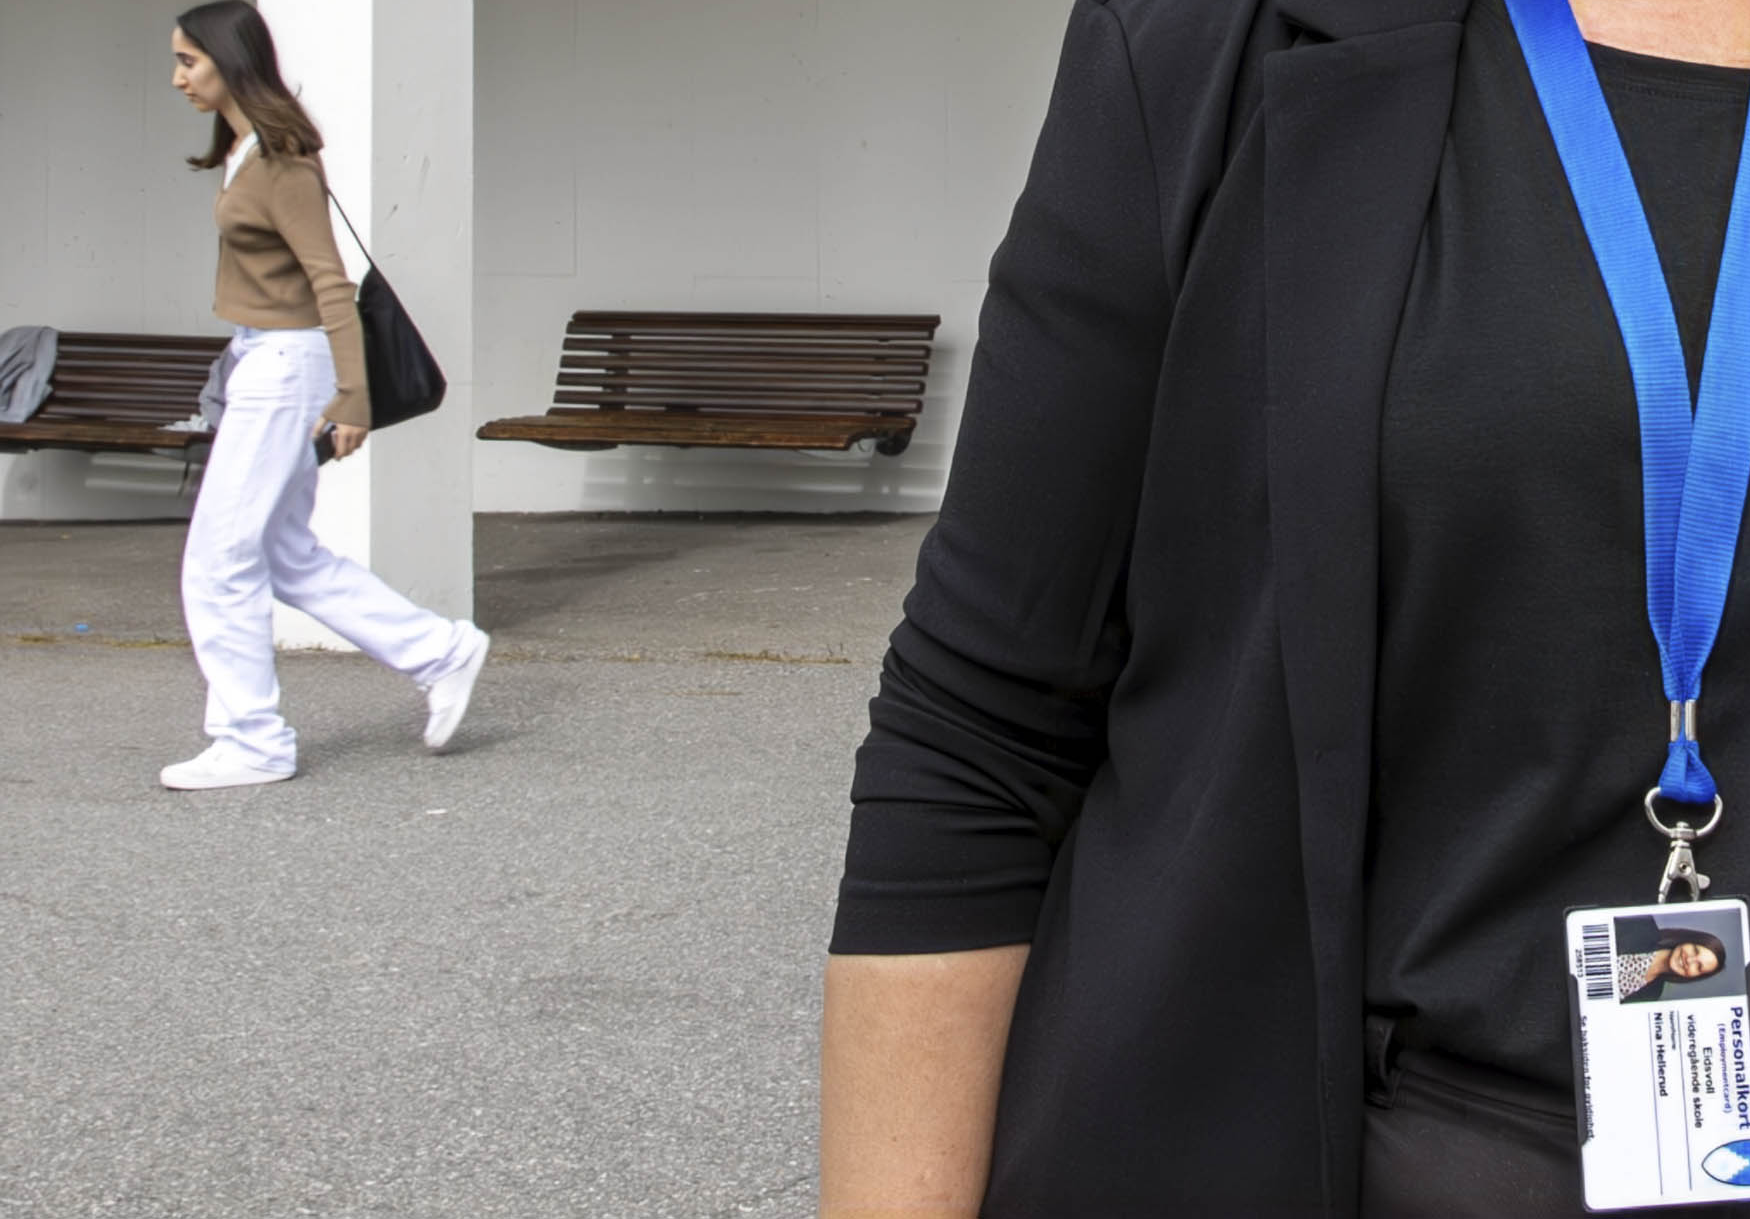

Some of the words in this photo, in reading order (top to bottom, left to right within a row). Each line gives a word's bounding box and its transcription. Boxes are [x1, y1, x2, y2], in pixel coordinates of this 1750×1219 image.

[1654, 1012, 1664, 1040] Nina
[1656, 1044, 1669, 1097] Hellerud
[1687, 1014, 1700, 1093] videregående
[1702, 1047, 1715, 1094] Eidsvoll
[1693, 1097, 1704, 1128] skole
